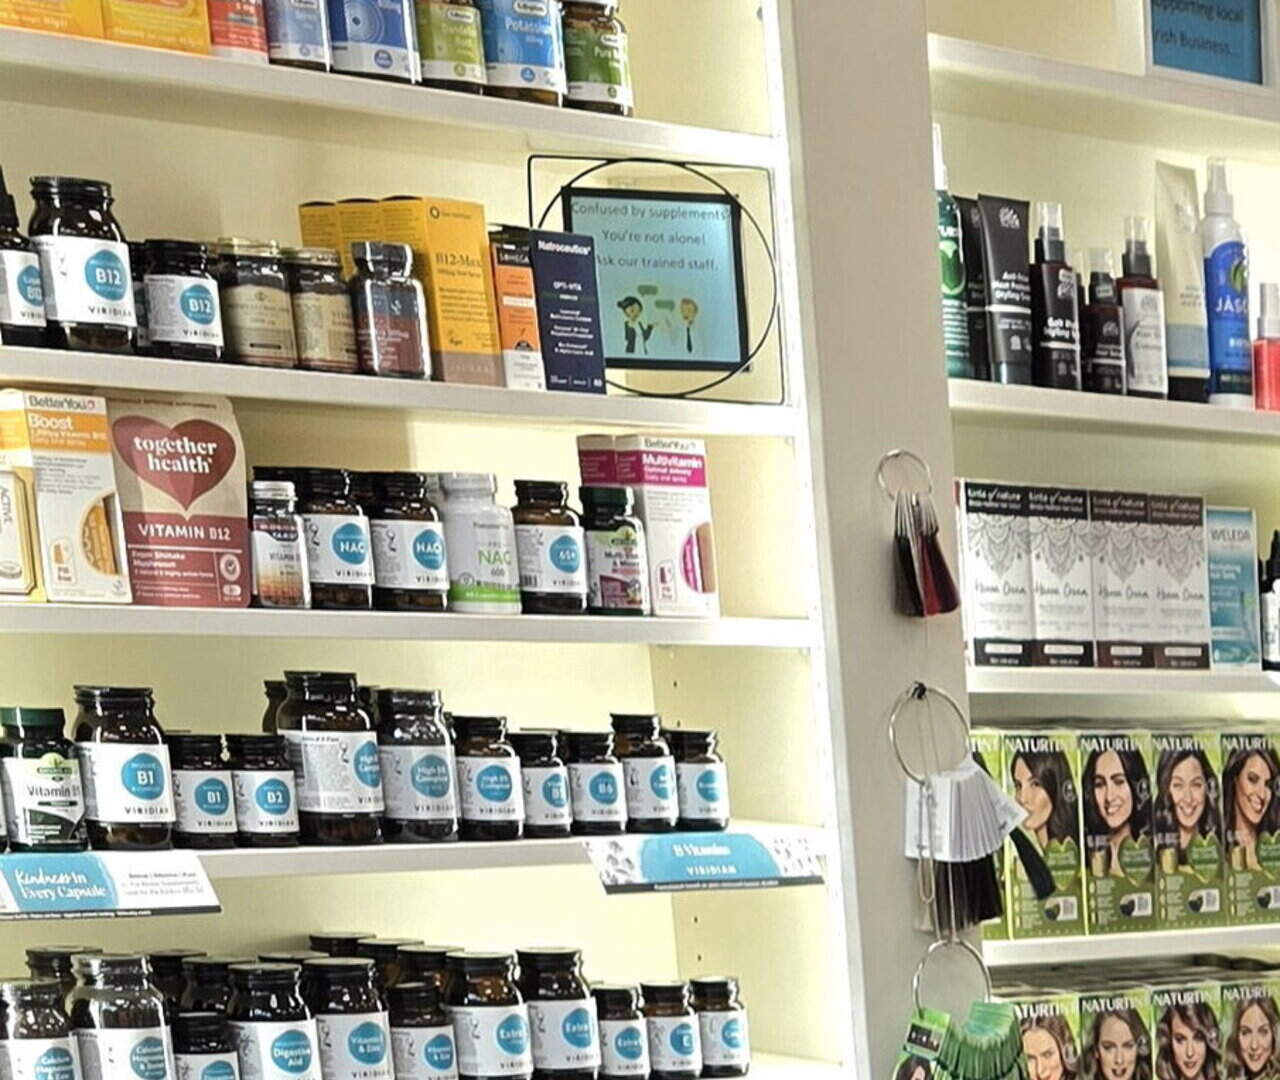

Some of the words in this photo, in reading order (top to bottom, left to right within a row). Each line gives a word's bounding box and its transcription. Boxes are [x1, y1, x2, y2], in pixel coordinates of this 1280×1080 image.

[571, 201, 628, 216] Confused
[631, 204, 646, 219] by
[602, 231, 642, 243] You're
[645, 233, 667, 245] not
[669, 232, 706, 246] alone!
[617, 257, 638, 268] our
[642, 256, 685, 269] trained
[688, 258, 719, 271] staff.
[95, 268, 122, 285] B12
[188, 298, 212, 313] B12
[29, 414, 73, 430] Boost
[133, 436, 218, 456] together
[147, 453, 208, 474] health
[138, 523, 205, 540] VITAMIN
[209, 527, 231, 541] B12
[478, 551, 512, 566] NAC
[1080, 736, 1140, 753] NATURTI
[136, 771, 154, 785] B1
